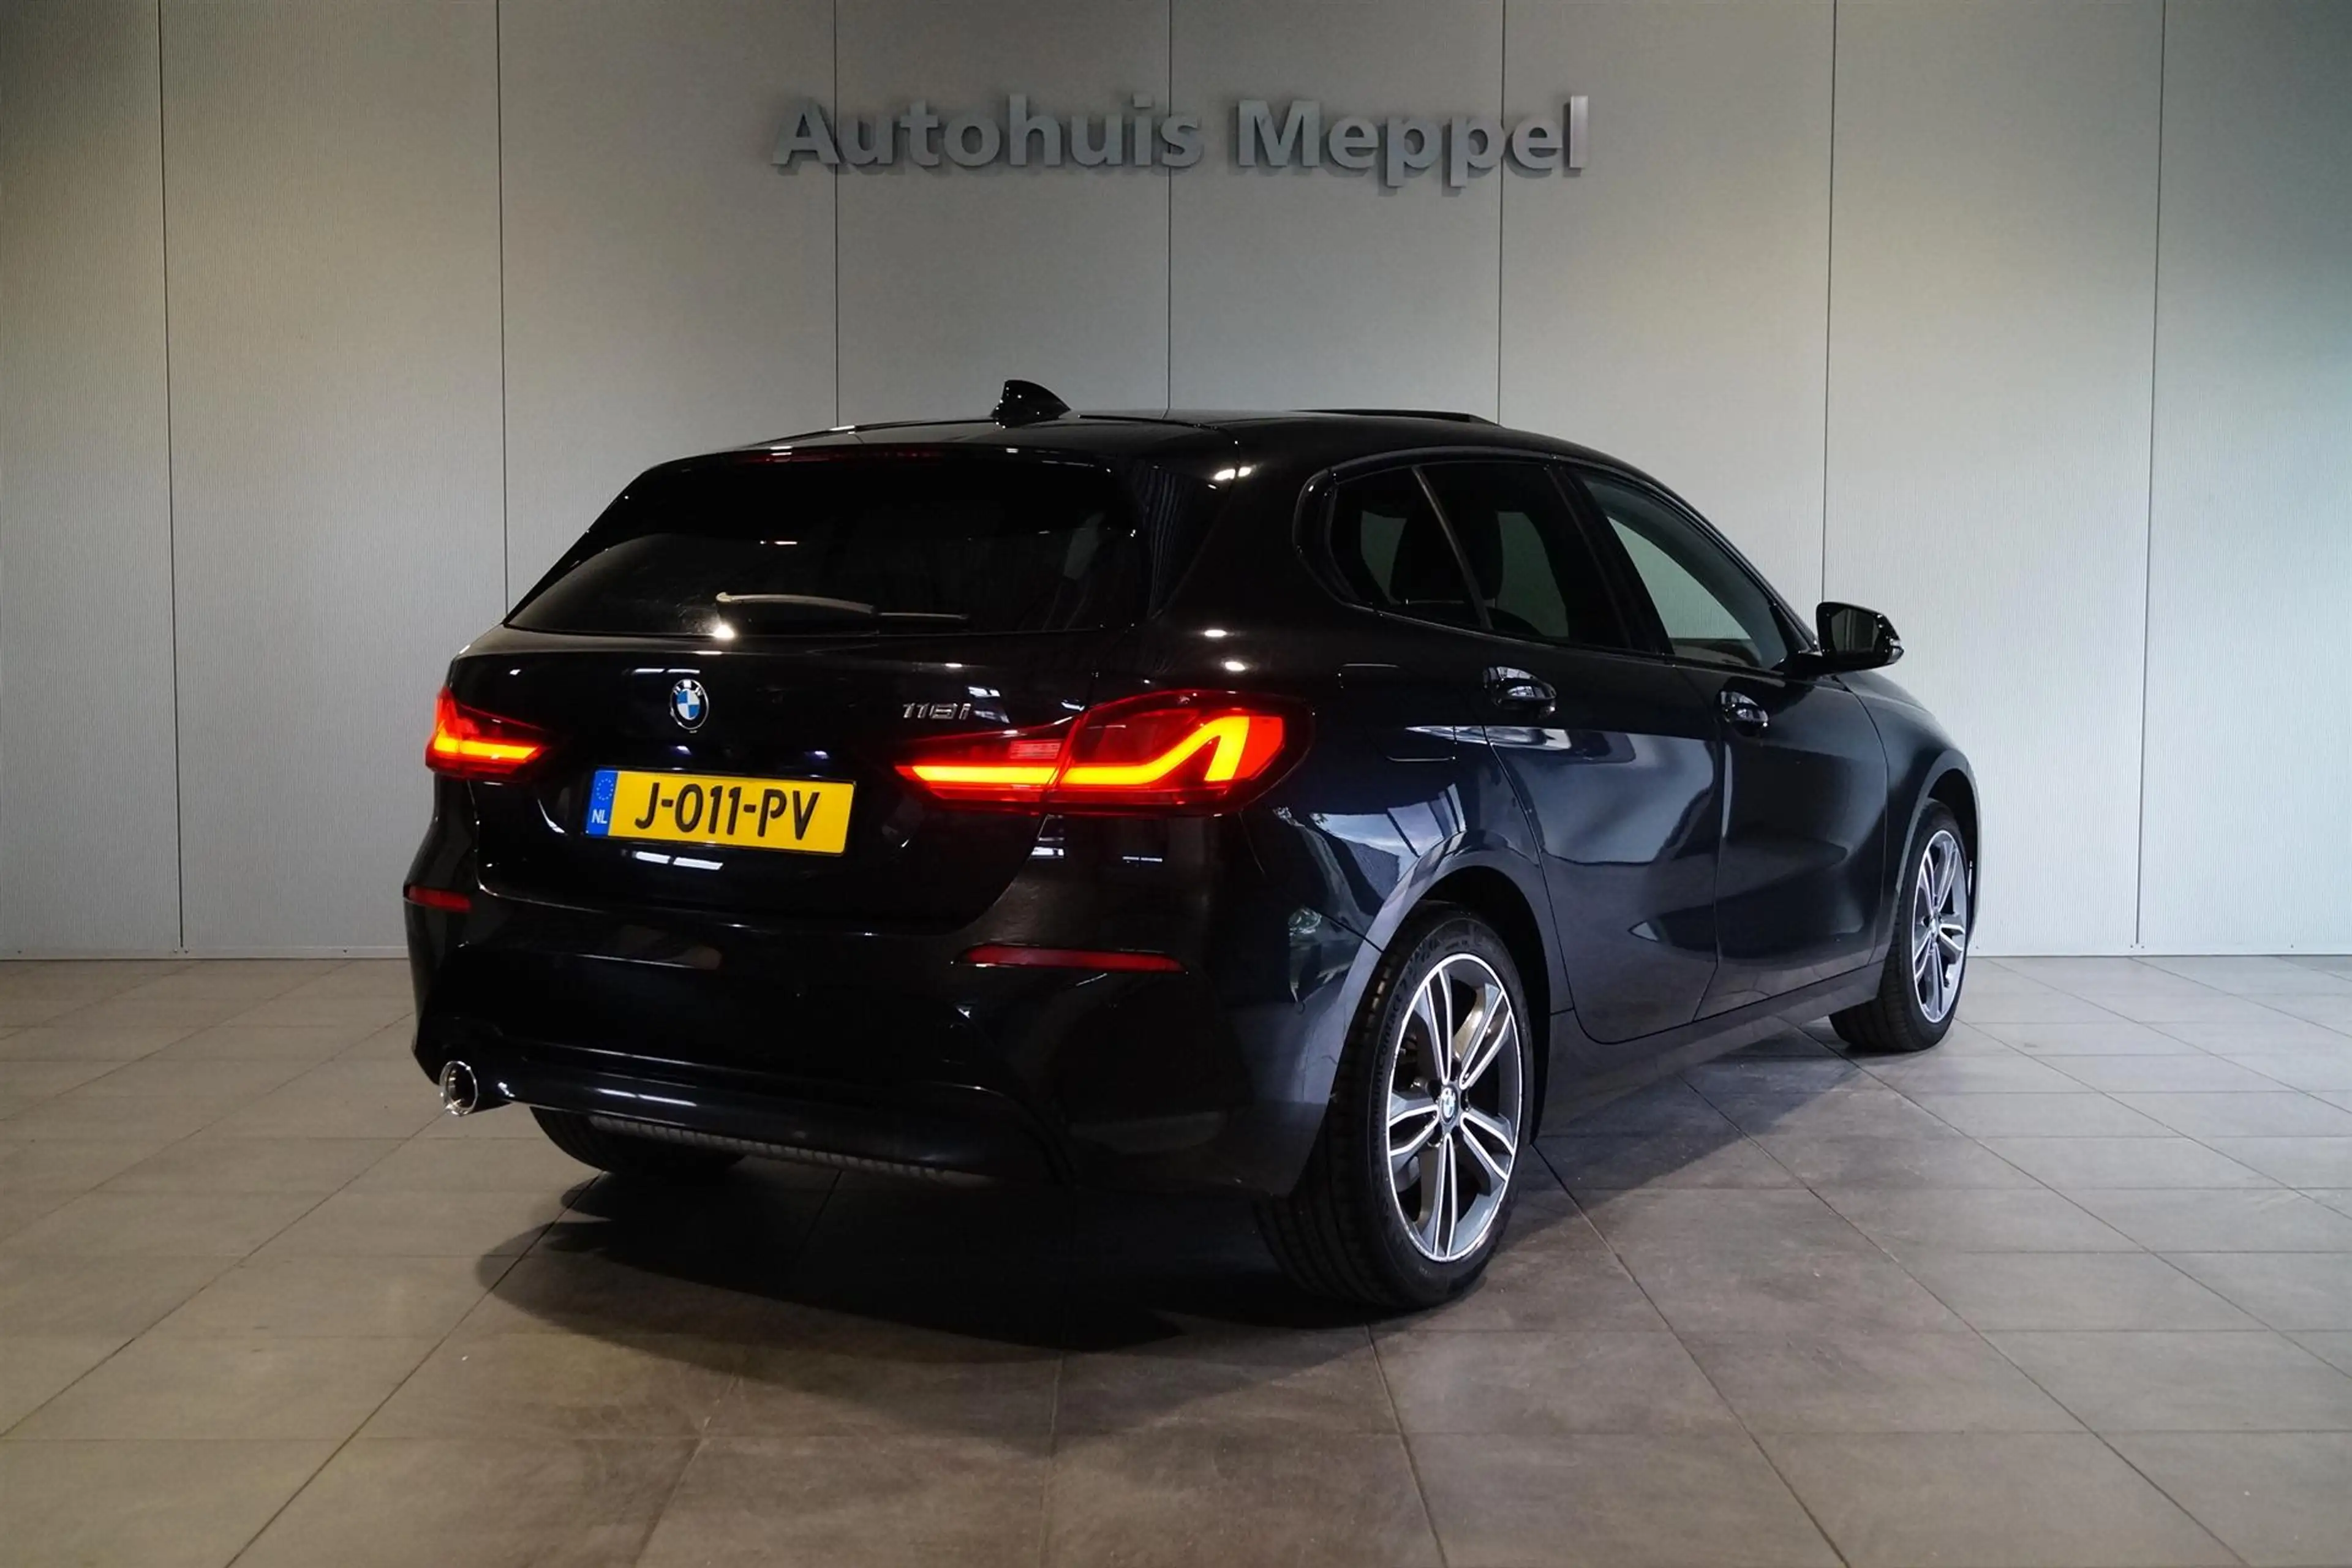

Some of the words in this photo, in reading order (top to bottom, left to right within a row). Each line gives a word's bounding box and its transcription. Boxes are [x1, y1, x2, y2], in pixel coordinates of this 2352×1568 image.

[772, 94, 1203, 168] Autohuis
[1237, 96, 1589, 187] Meppel
[903, 703, 972, 720] 118i
[591, 809, 608, 824] NL
[635, 782, 820, 840] J-011-PV
